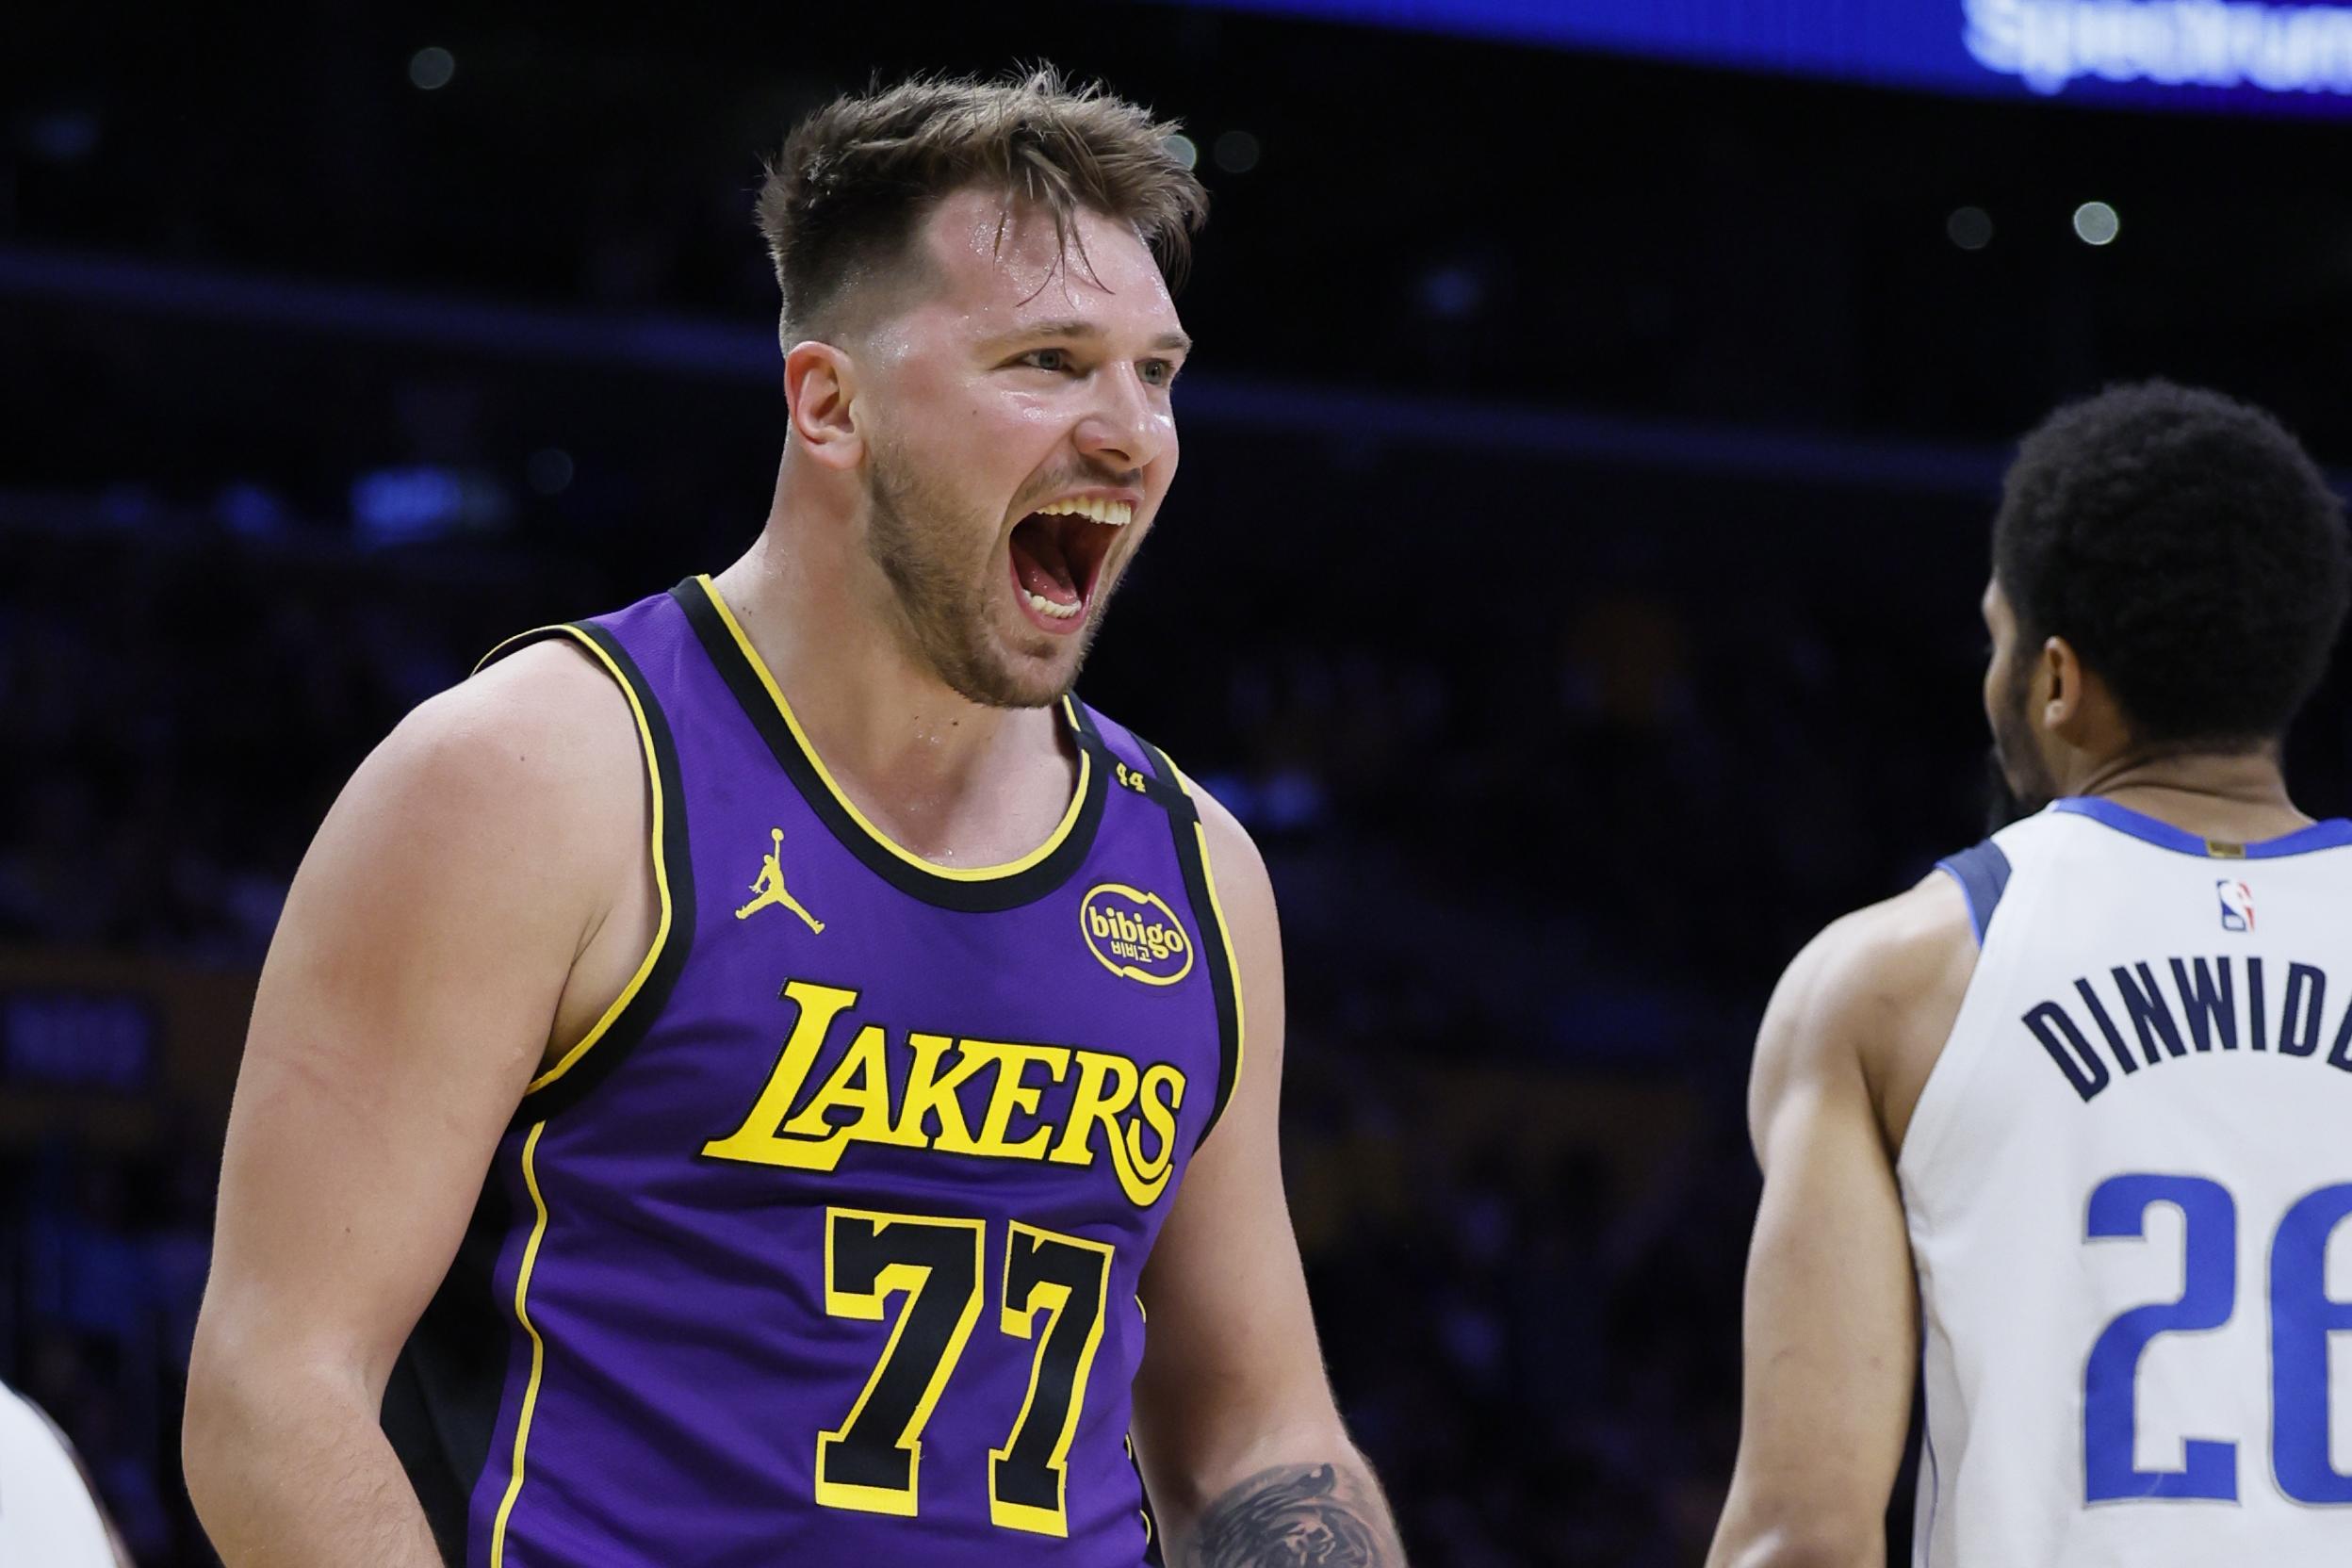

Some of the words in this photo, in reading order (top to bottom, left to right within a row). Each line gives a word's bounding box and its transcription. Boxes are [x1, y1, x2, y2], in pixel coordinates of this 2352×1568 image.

[1117, 762, 1147, 793] 44
[1088, 906, 1184, 959] bibigo
[1111, 941, 1152, 963] 비비고
[701, 979, 1187, 1207] LAKERS
[815, 1206, 1116, 1538] 77
